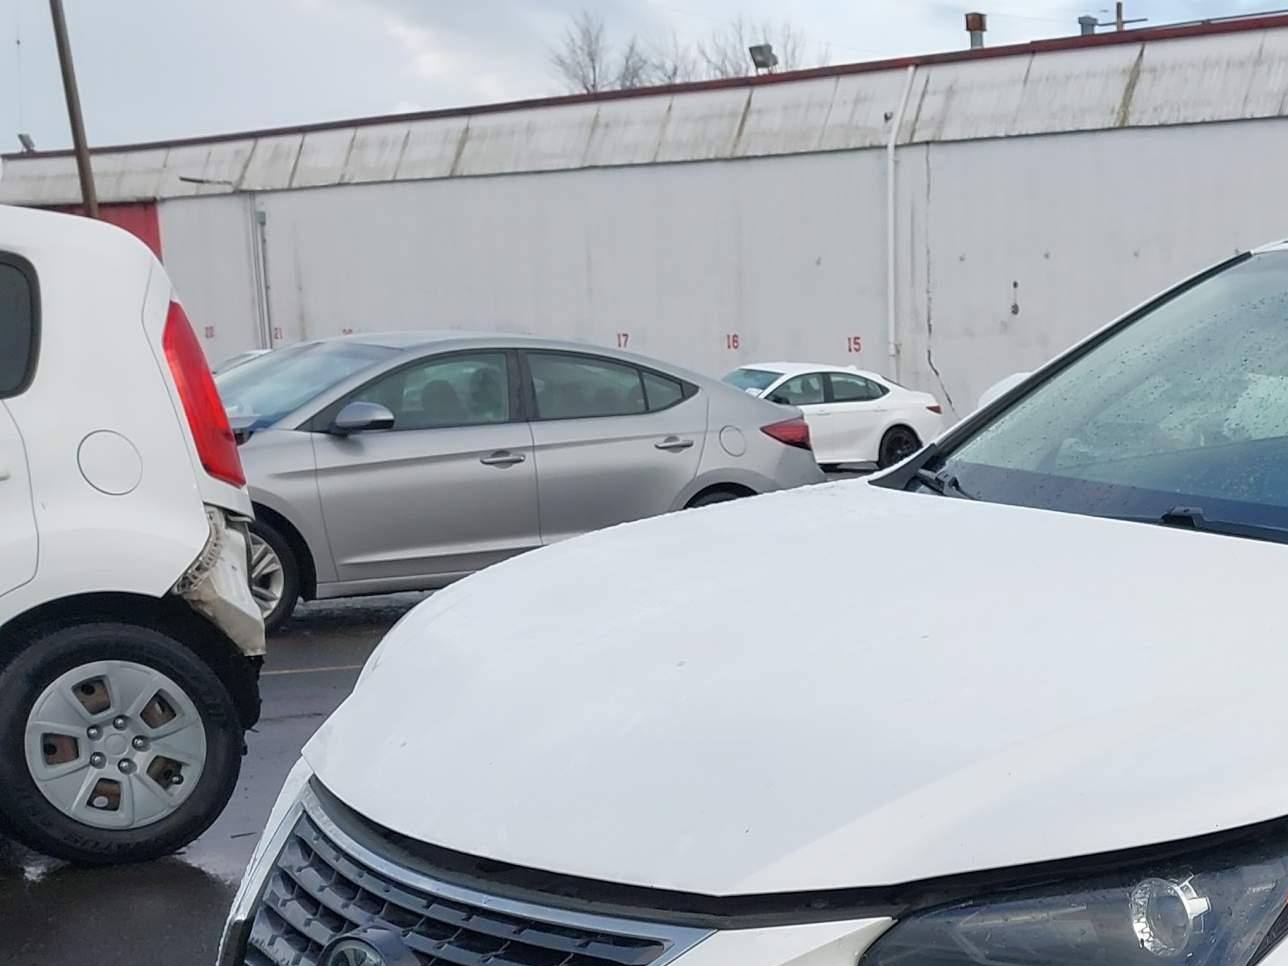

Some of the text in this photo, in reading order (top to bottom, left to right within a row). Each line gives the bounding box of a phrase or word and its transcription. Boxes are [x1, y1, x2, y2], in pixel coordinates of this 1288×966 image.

[616, 333, 629, 349] 17
[726, 334, 740, 349] 16
[847, 336, 862, 352] 15
